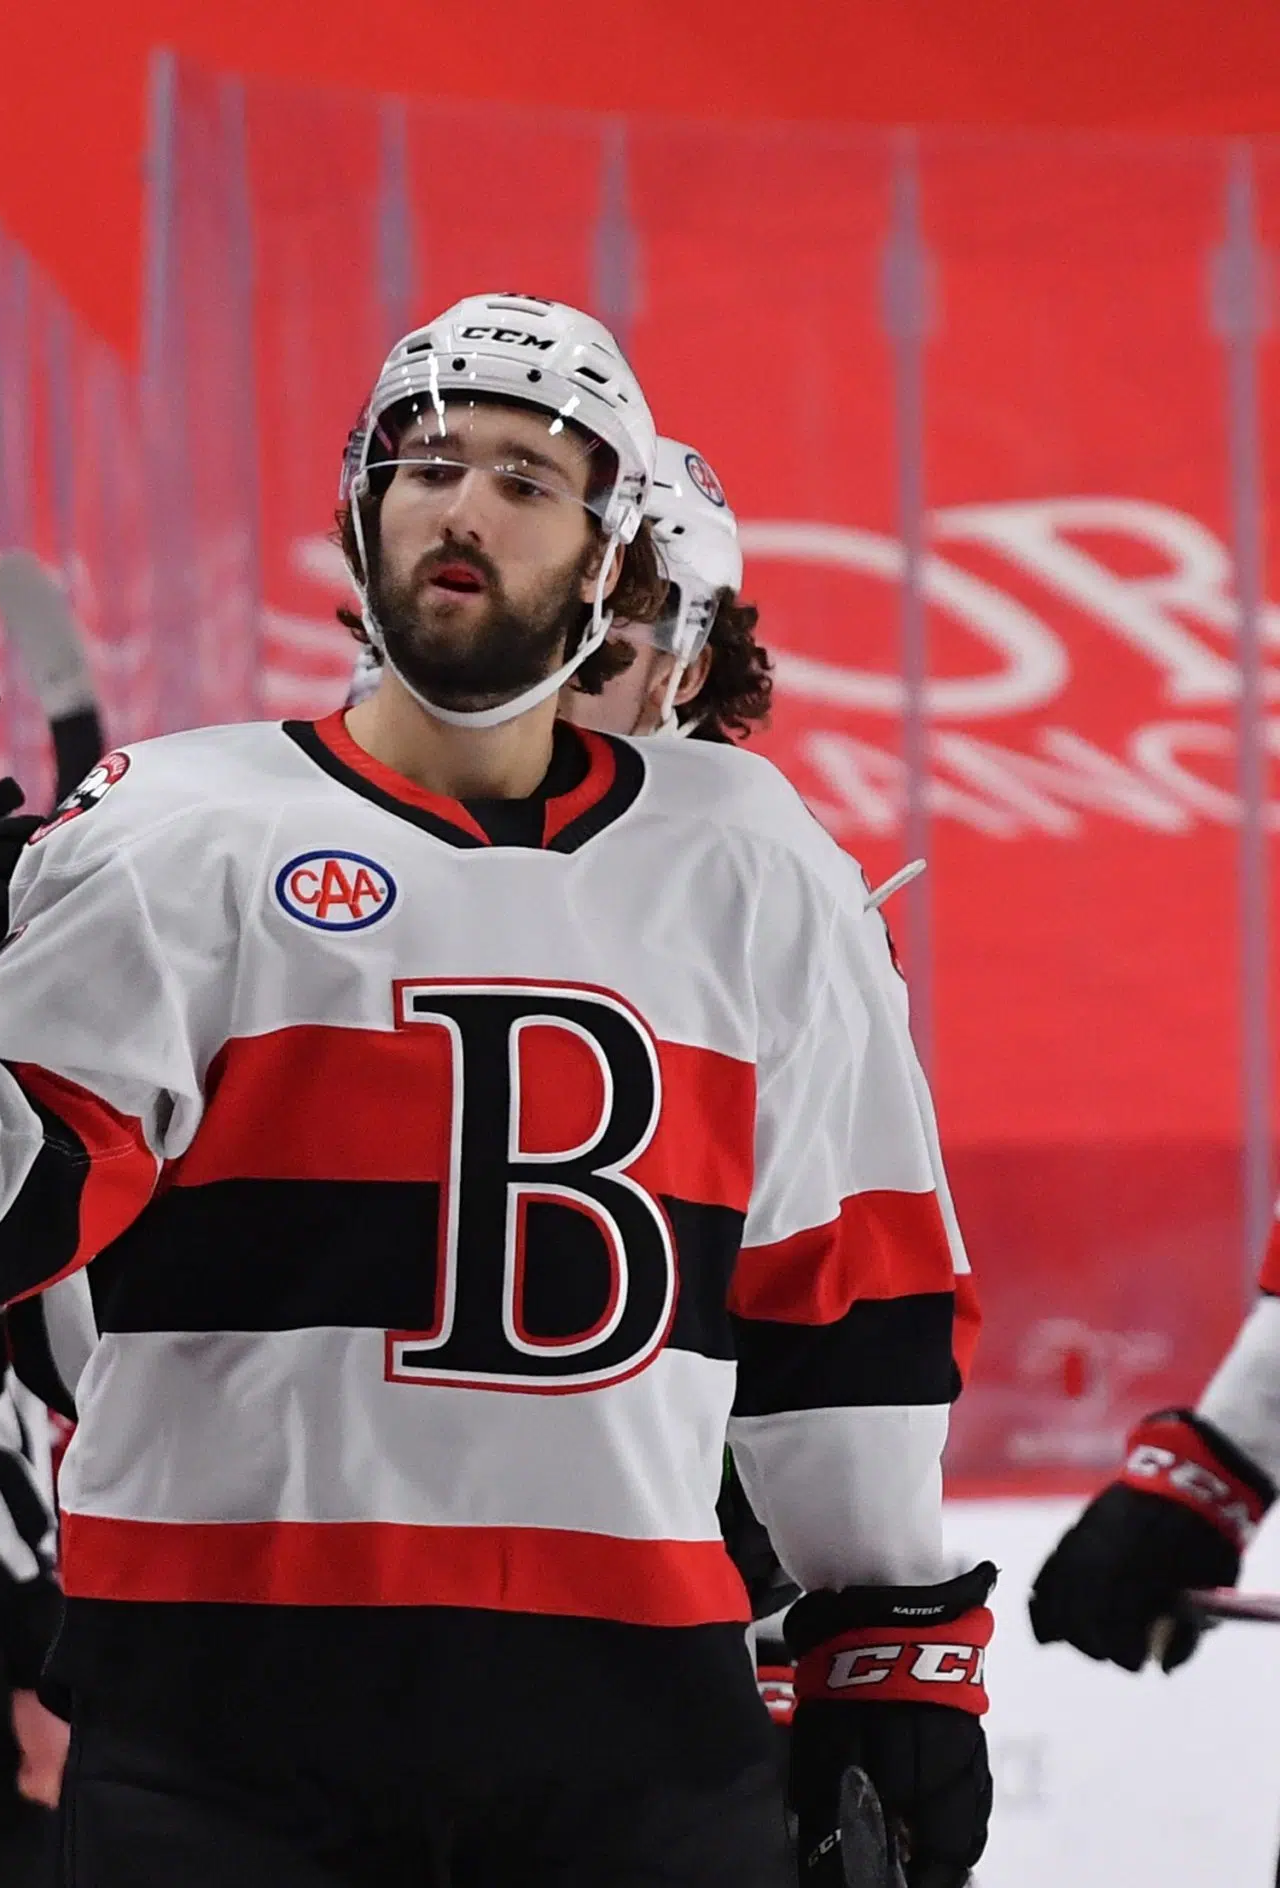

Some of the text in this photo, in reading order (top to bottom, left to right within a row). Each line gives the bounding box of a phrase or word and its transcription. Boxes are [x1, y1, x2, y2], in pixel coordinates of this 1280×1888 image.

[461, 326, 557, 351] CCM
[289, 859, 383, 919] CAA
[384, 976, 680, 1396] B
